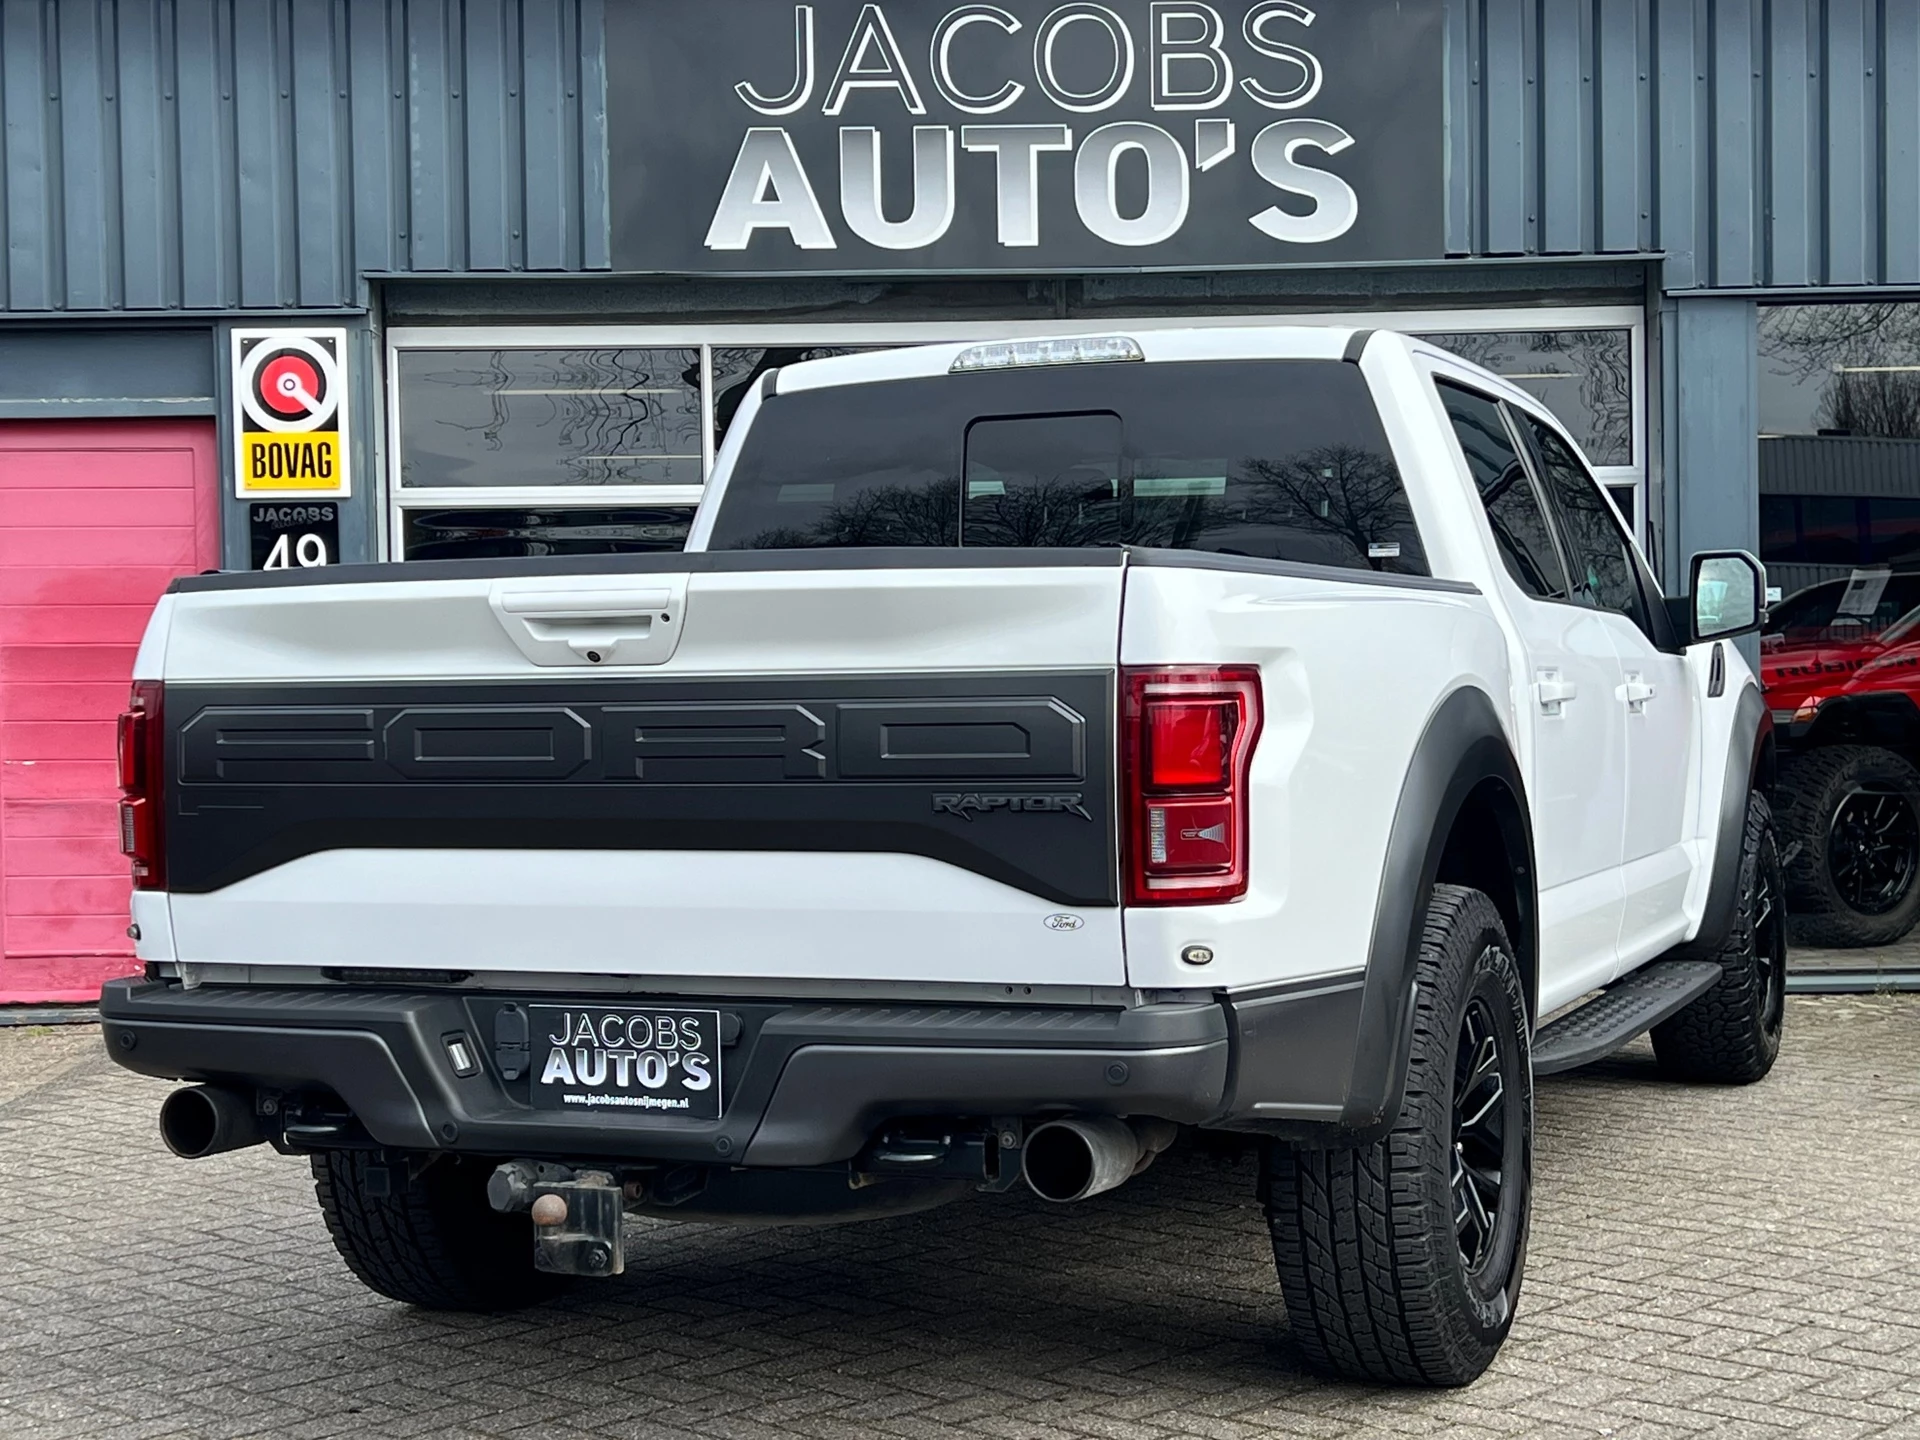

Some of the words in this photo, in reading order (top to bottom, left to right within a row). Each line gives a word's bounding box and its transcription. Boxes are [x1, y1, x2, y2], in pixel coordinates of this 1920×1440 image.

[734, 0, 1323, 115] JACOBS
[704, 118, 1358, 249] AUTO'S
[252, 442, 332, 478] BOVAG
[253, 506, 334, 522] JACOBS
[262, 533, 327, 571] 49
[178, 699, 1088, 784] FORD
[932, 792, 1093, 822] RAPTOR
[1051, 915, 1077, 929] Ford
[549, 1012, 702, 1050] JACOBS
[540, 1047, 711, 1091] AUTO'S
[563, 1093, 689, 1110] www.jacobsautosnijmegen.nl
